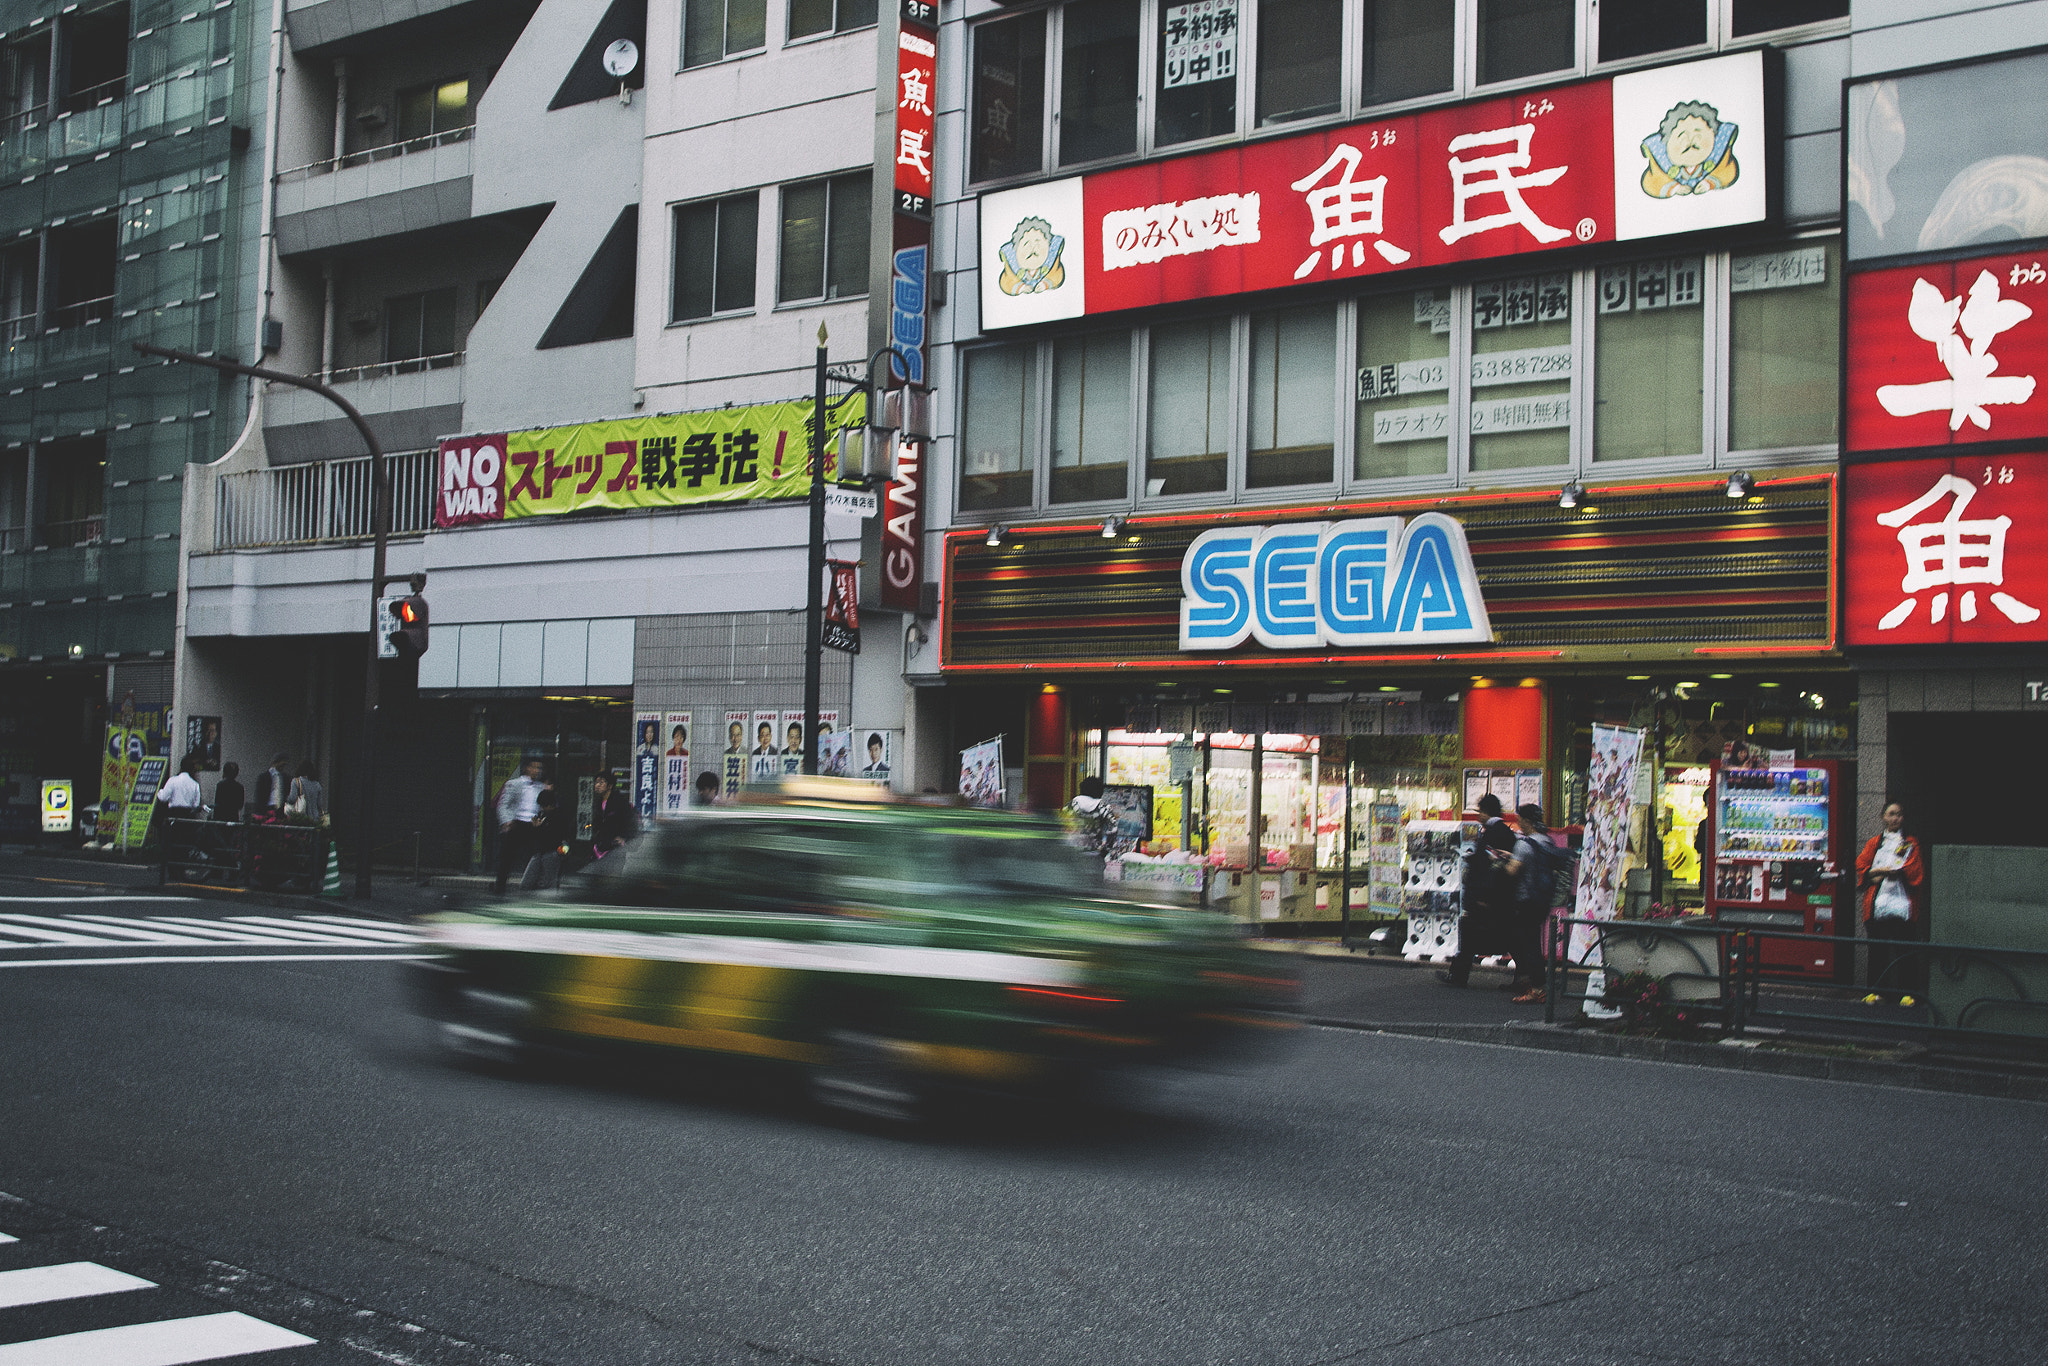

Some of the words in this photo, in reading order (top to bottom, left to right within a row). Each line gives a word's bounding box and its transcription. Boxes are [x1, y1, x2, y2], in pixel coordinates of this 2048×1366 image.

[908, 0, 930, 19] 3F
[1167, 8, 1236, 45] 予約承
[897, 68, 932, 176] 魚民
[1523, 98, 1555, 119] たみ
[1370, 129, 1396, 150] うお
[902, 194, 924, 213] 2F
[1291, 123, 1572, 280] 魚民
[1116, 208, 1239, 251] のみくい処
[2009, 262, 2046, 287] わら
[891, 243, 928, 385] SEGA
[1475, 287, 1567, 325] 予約承
[1376, 412, 1448, 436] カラオケ
[443, 444, 500, 491] NO
[1983, 465, 2014, 486] うお
[444, 486, 498, 518] WAR
[886, 441, 919, 589] GAME
[1876, 473, 2041, 631] 魚
[1183, 515, 1486, 647] SEGA
[51, 789, 67, 809] P
